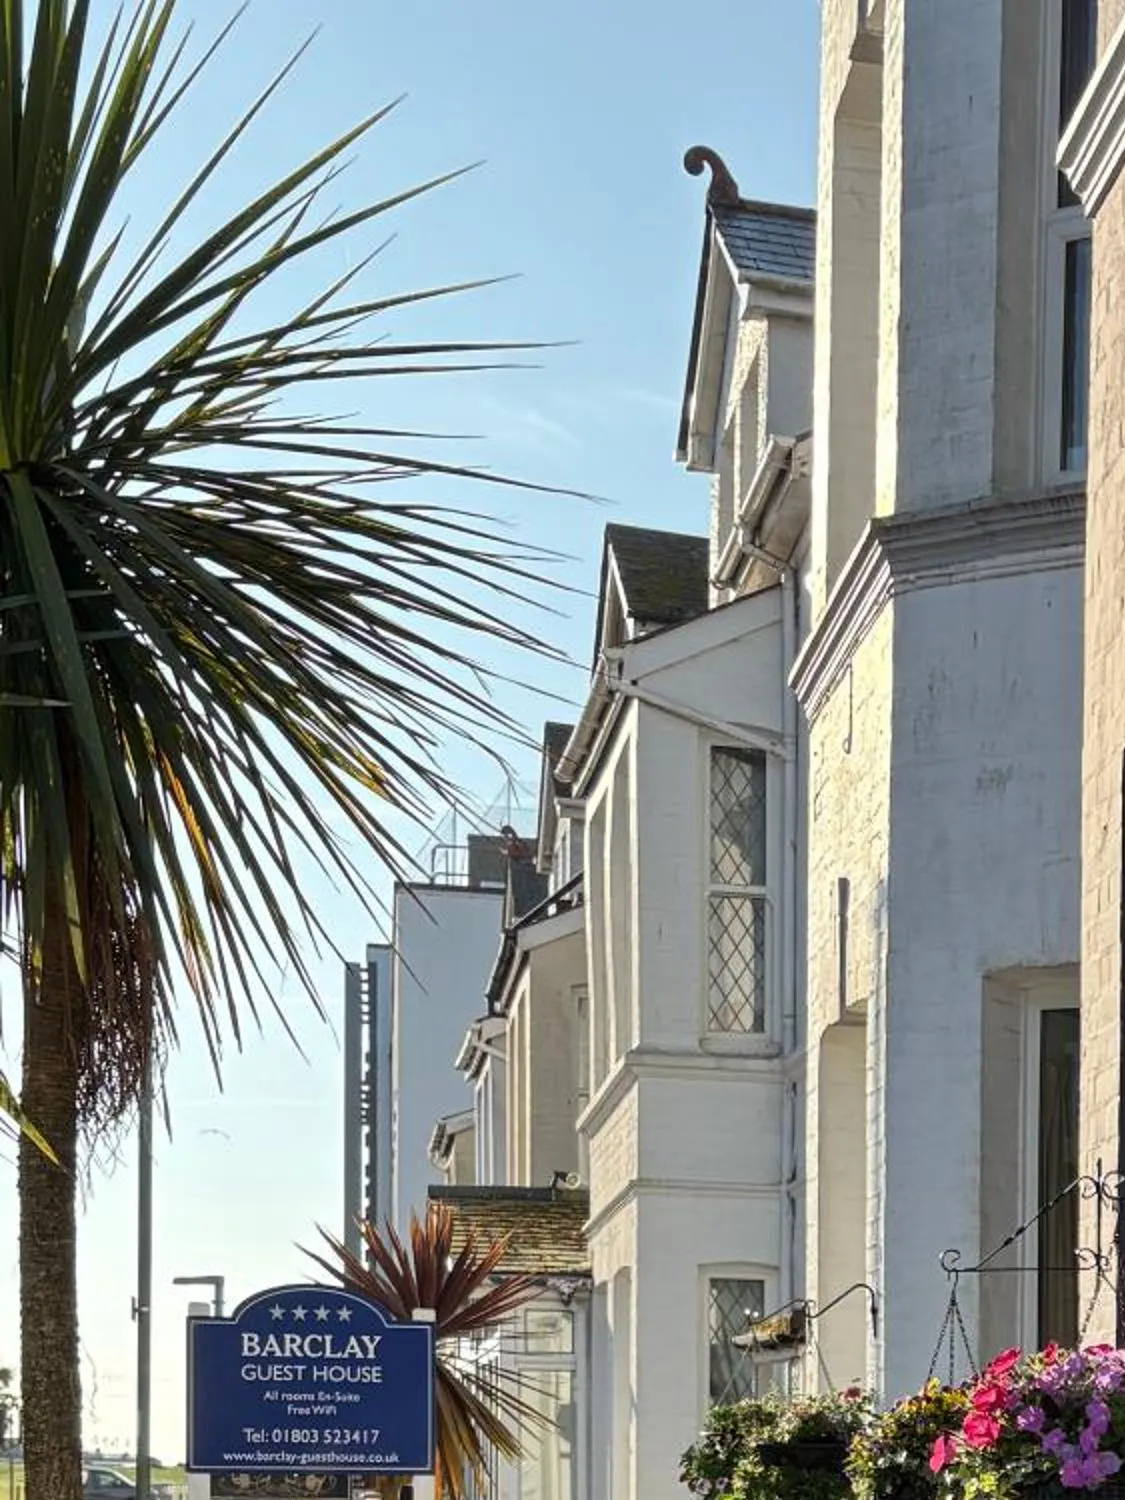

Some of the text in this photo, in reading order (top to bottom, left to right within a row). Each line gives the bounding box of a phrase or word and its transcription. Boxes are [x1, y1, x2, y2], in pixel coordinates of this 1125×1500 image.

[241, 1333, 382, 1359] BARCLAY
[241, 1363, 383, 1383] GUEST HOUSE
[263, 1390, 361, 1402] All rooms En-Suite
[287, 1405, 310, 1415] Free
[242, 1428, 380, 1444] Tel: 01803 523417
[223, 1450, 400, 1465] www.barclay-guesthouse.co.uk
